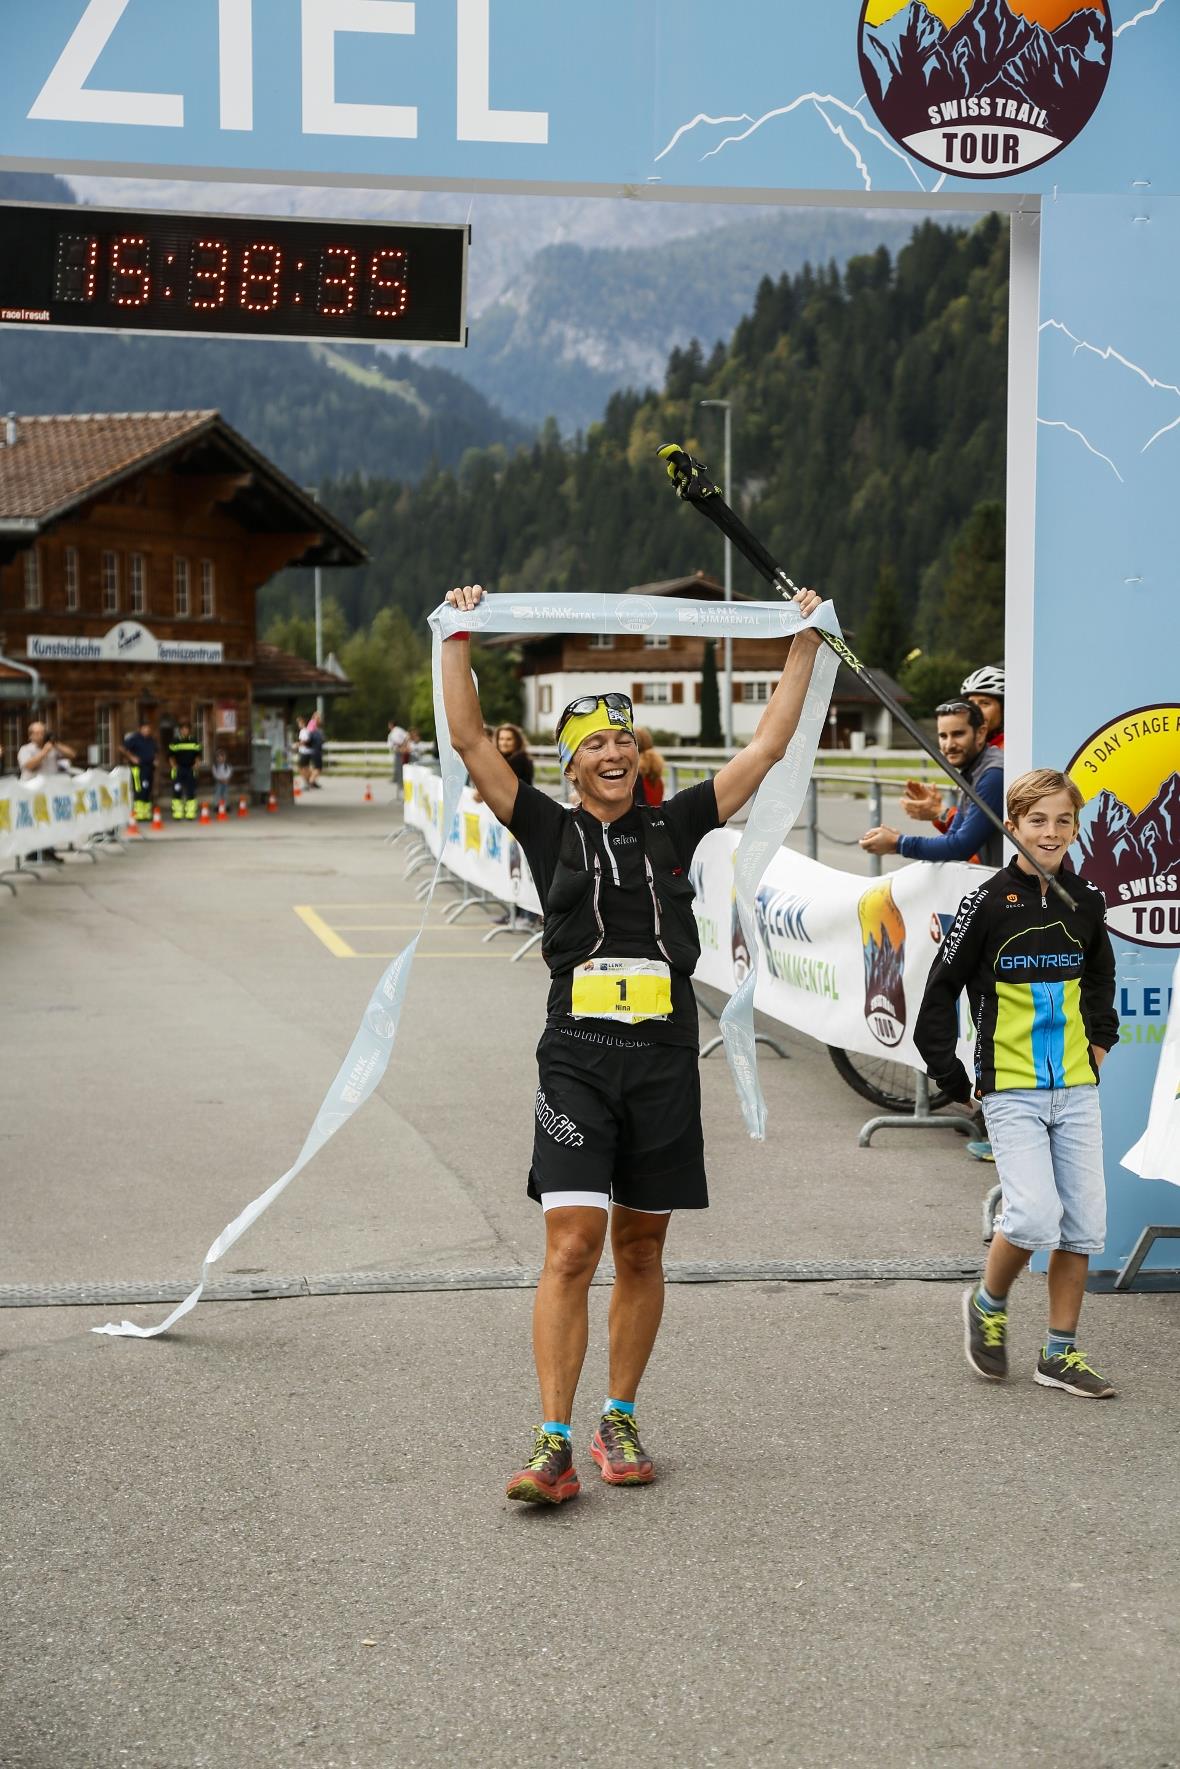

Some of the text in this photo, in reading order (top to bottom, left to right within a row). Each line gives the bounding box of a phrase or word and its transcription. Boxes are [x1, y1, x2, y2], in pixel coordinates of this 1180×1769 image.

[26, 0, 549, 144] ZIEL
[927, 97, 1048, 129] SWISS TRAIL
[942, 132, 1020, 164] TOUR
[87, 238, 408, 316] 15:38:35
[699, 614, 760, 625] SIMMENTAL
[31, 638, 101, 658] Kunsteisbahn
[157, 641, 221, 660] Tenniszentrum
[1084, 760, 1098, 773] 3
[1093, 733, 1121, 762] DAY
[1123, 716, 1170, 742] STAGE
[1118, 874, 1177, 901] SWISS
[1000, 953, 1084, 969] GANTRISCH
[615, 978, 627, 1001] 1
[1120, 987, 1172, 1016] LE
